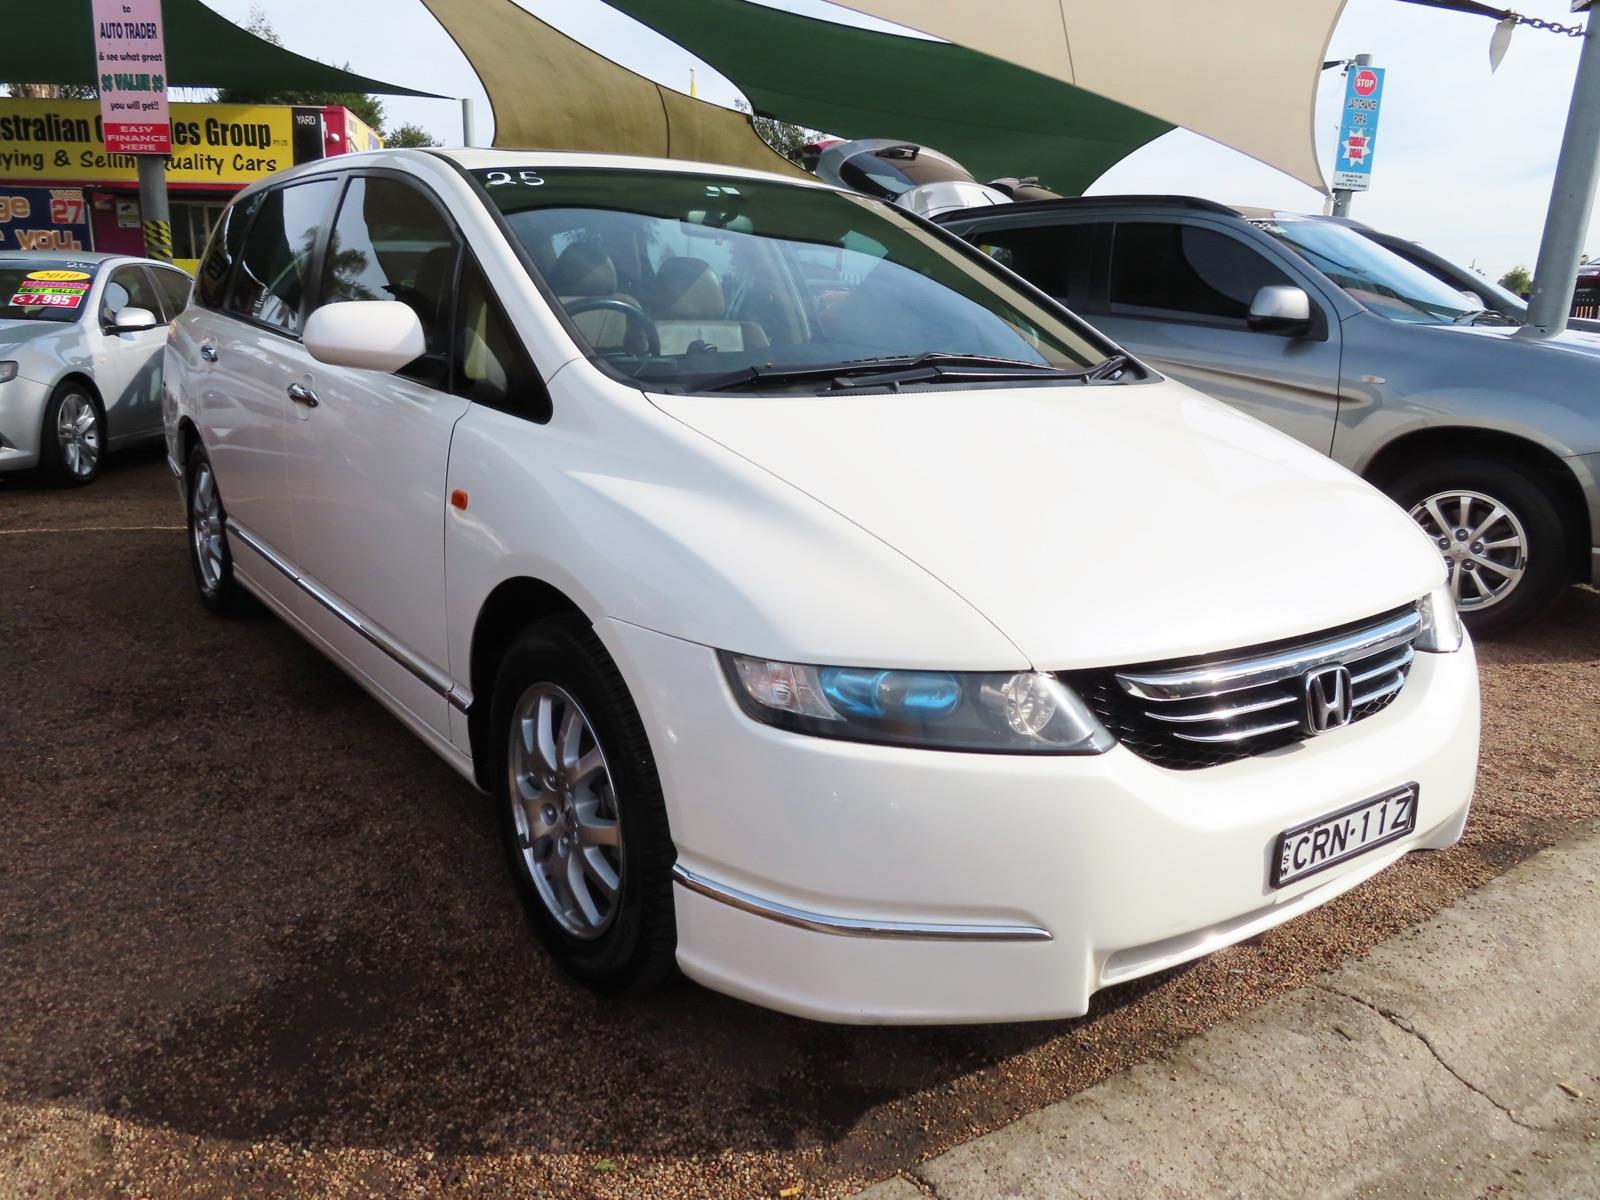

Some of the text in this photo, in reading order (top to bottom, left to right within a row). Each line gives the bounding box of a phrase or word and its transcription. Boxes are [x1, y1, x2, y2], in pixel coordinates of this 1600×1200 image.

[123, 5, 131, 13] to
[101, 22, 157, 39] AUTO TRADER
[106, 53, 119, 61] see
[120, 52, 140, 61] what
[142, 53, 162, 62] great
[114, 74, 150, 92] VALUE
[1356, 79, 1374, 88] STOP
[110, 102, 124, 111] you
[126, 101, 140, 110] will
[296, 115, 316, 125] YARD
[0, 113, 91, 143] stralian
[169, 118, 201, 146] les
[206, 120, 271, 150] Group
[120, 125, 153, 133] EASY
[107, 134, 167, 142] FINANCE
[120, 143, 157, 151] HERE
[53, 149, 71, 167] &
[80, 151, 138, 168] Sellin
[233, 153, 277, 172] Cars
[487, 171, 545, 186] 25
[52, 199, 82, 224] 27
[1280, 841, 1291, 877] NSW
